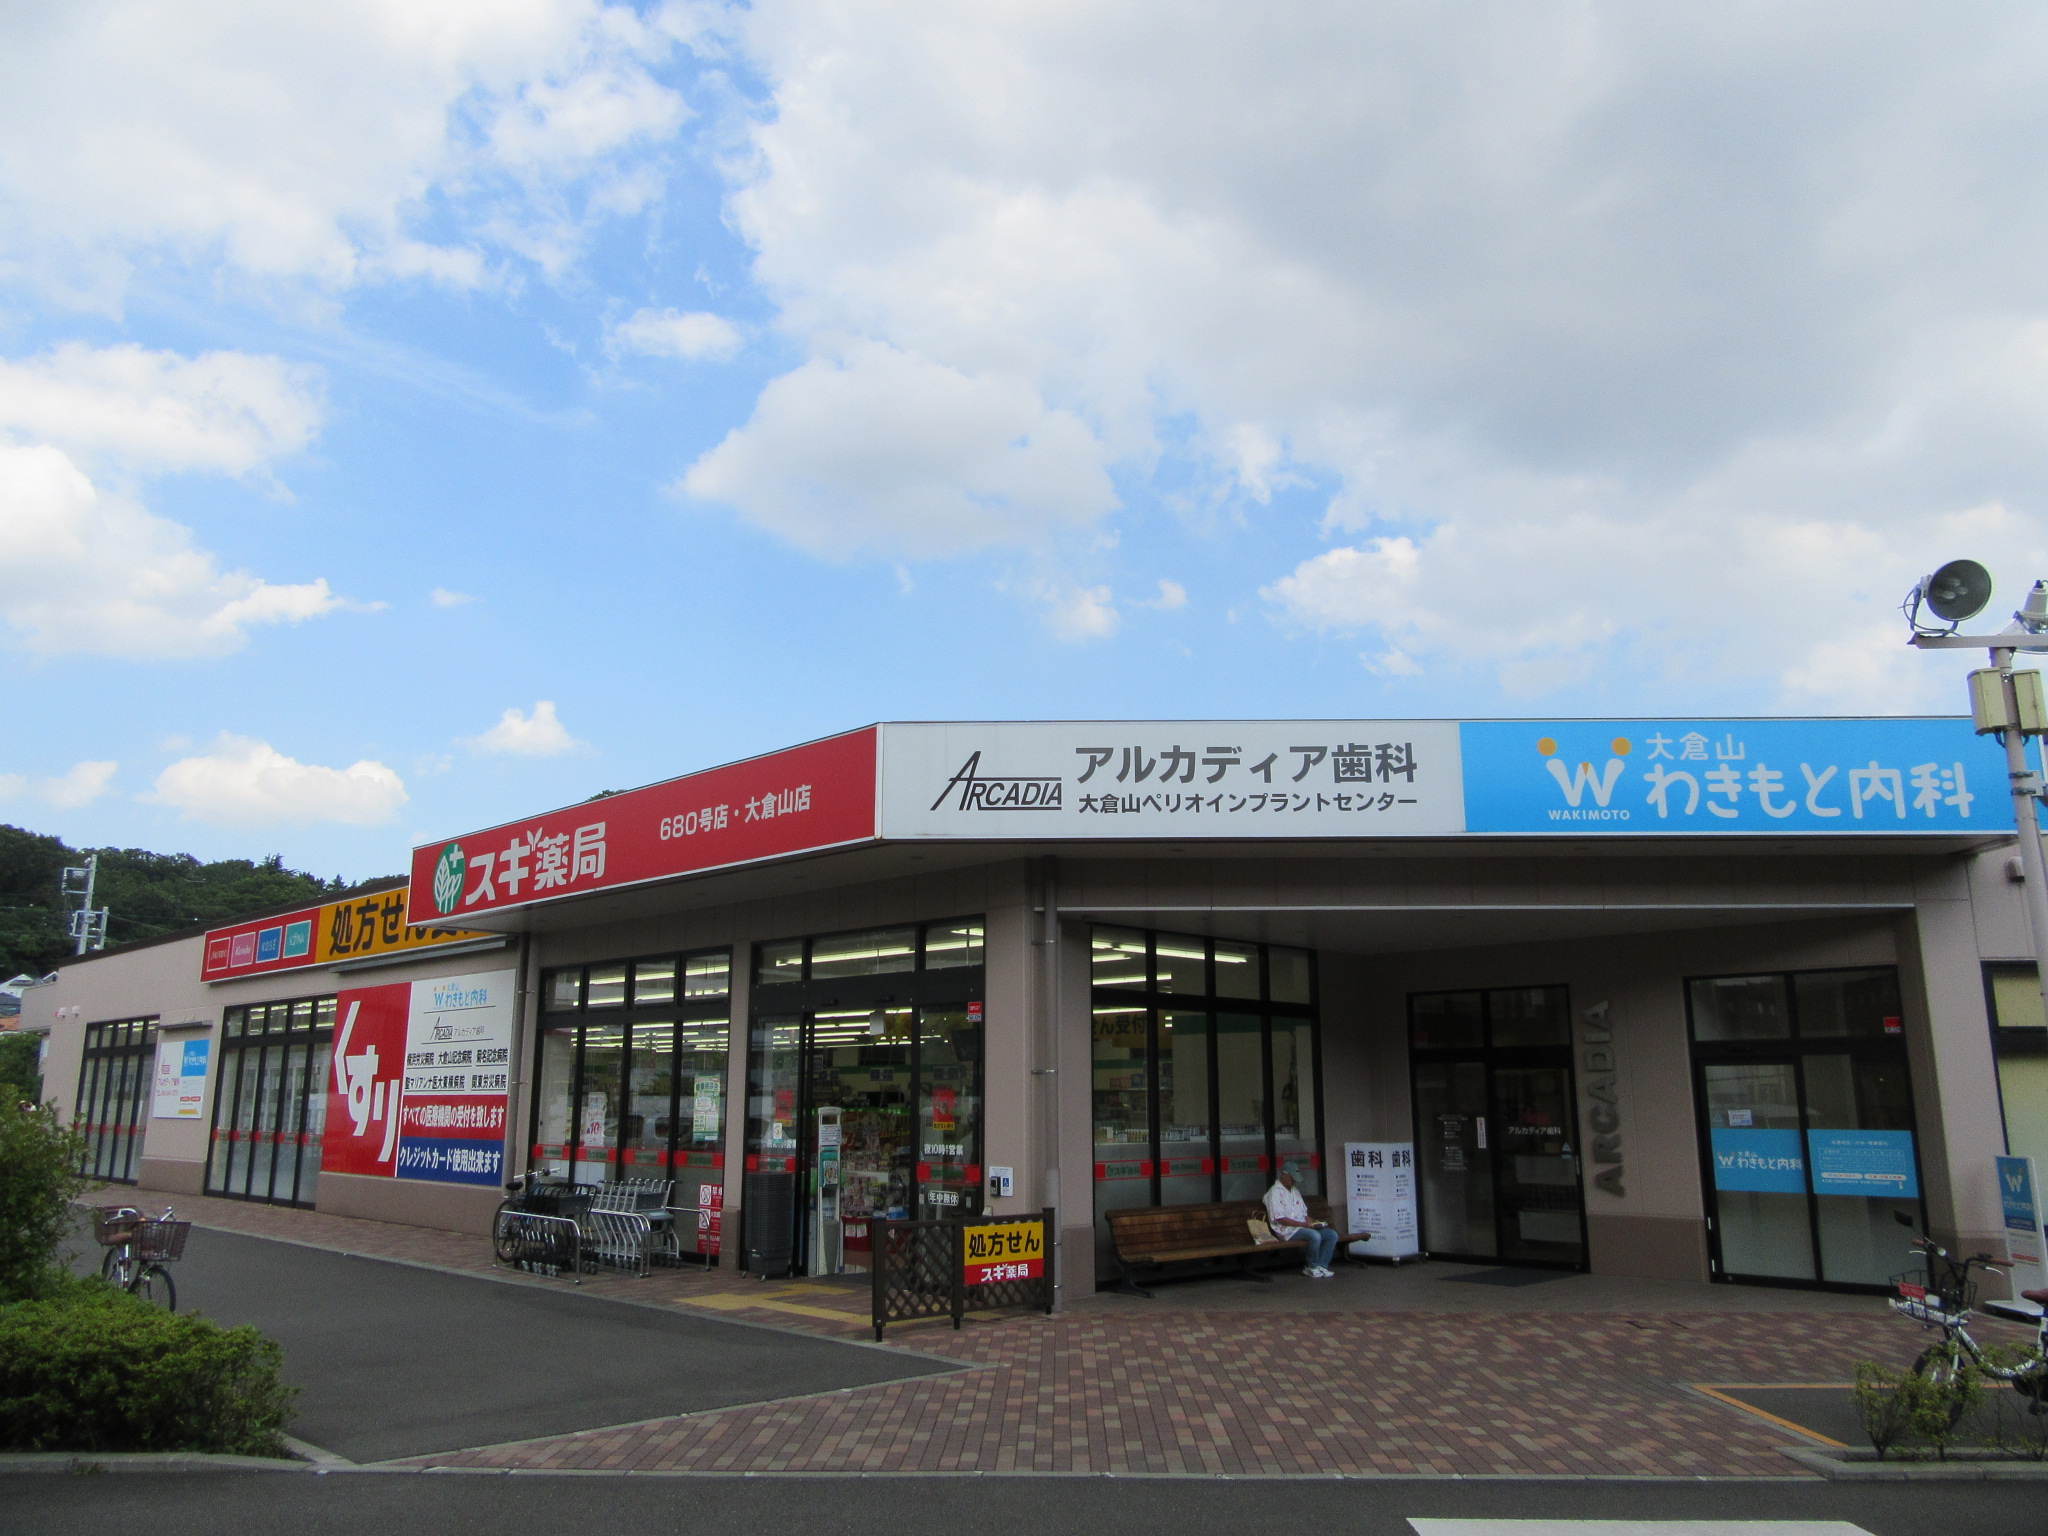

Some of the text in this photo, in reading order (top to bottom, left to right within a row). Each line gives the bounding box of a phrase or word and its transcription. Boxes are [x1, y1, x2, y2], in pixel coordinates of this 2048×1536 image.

[1645, 731, 1745, 761] 大倉山
[1075, 742, 1418, 785] アルカディア歯科
[930, 751, 1063, 811] ARCADIA
[1643, 761, 1975, 820] わきもと内科
[659, 784, 812, 841] 680号店・大倉山店
[1078, 792, 1418, 815] 大倉山ペリオインプラントセンター
[1548, 809, 1631, 821] WAKIMOTO
[465, 822, 607, 906] スギ薬局
[445, 988, 488, 1008] わきもと内科
[438, 1050, 472, 1065] 大倉山記念病院
[334, 1000, 400, 1163] くすり
[1582, 1000, 1626, 1198] ARCADIA
[403, 1104, 504, 1128] すべての医療機関の受付を致します
[1508, 1126, 1561, 1135] アルカディア歯科
[400, 1146, 501, 1173] クレジットカード使用出来ます
[1351, 1150, 1383, 1168] 歯科
[1392, 1149, 1411, 1167] 歯科
[1737, 1157, 1802, 1170] わきもと内科
[929, 1193, 959, 1205] 年中無休
[969, 1230, 1040, 1258] 処方せん
[981, 1263, 1029, 1282] スギ薬局
